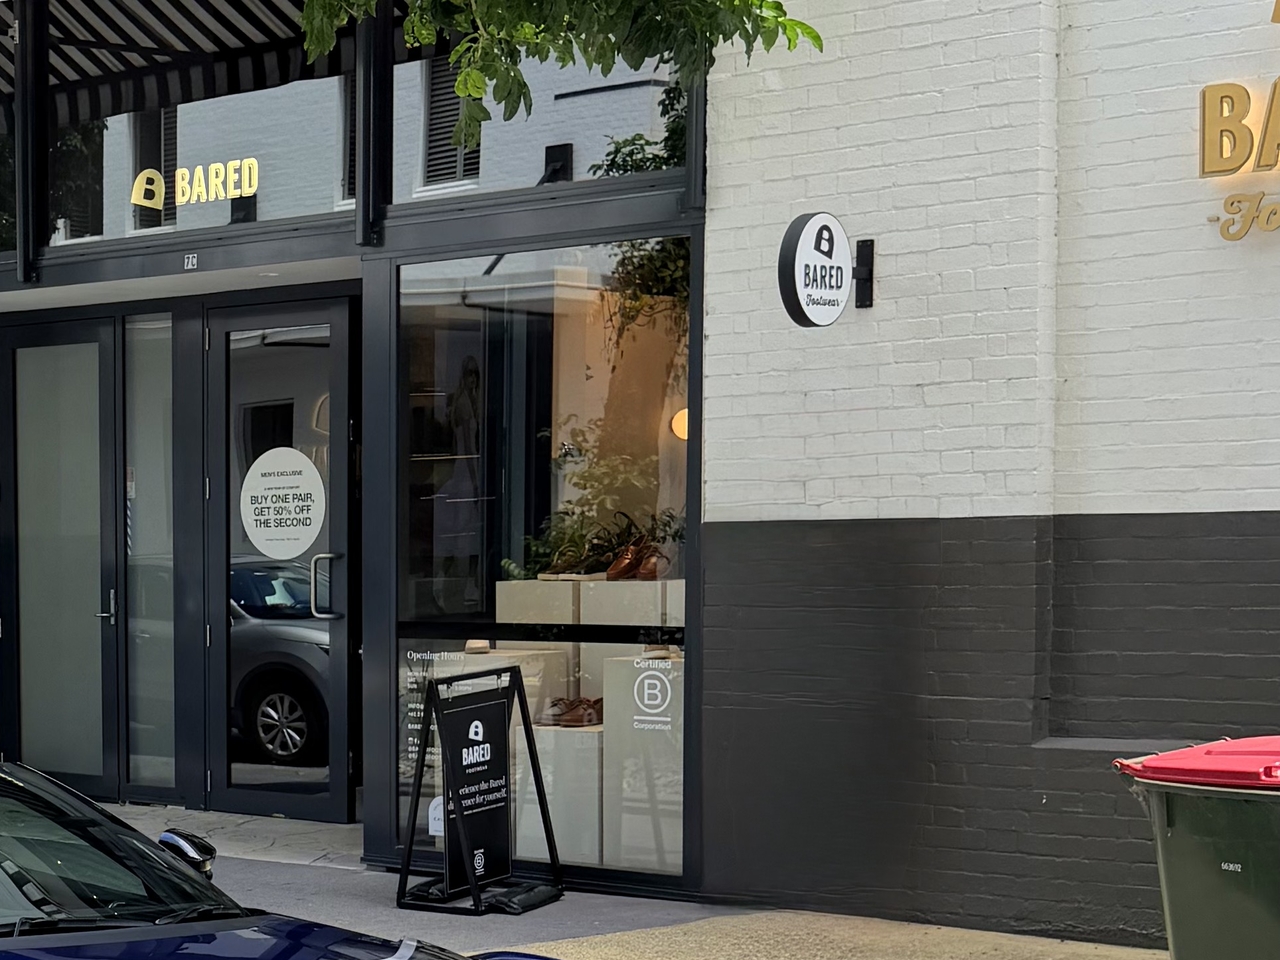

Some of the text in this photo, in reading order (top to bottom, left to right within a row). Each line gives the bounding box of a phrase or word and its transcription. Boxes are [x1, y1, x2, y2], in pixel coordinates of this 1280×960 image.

[175, 157, 258, 206] BARED
[186, 255, 196, 267] 7C
[804, 263, 843, 290] BARED
[805, 293, 839, 307] Footwear
[250, 492, 315, 505] BUY ONE PAIR,
[254, 505, 311, 516] GET 50% OFF
[254, 517, 312, 528] THE SECOND
[407, 650, 464, 661] Opening Hours
[633, 659, 672, 669] Certified
[644, 679, 662, 704] B
[633, 721, 672, 731] Corporation
[462, 743, 491, 766] BARED
[479, 781, 489, 790] the
[489, 775, 506, 789] Bared
[475, 793, 484, 804] for
